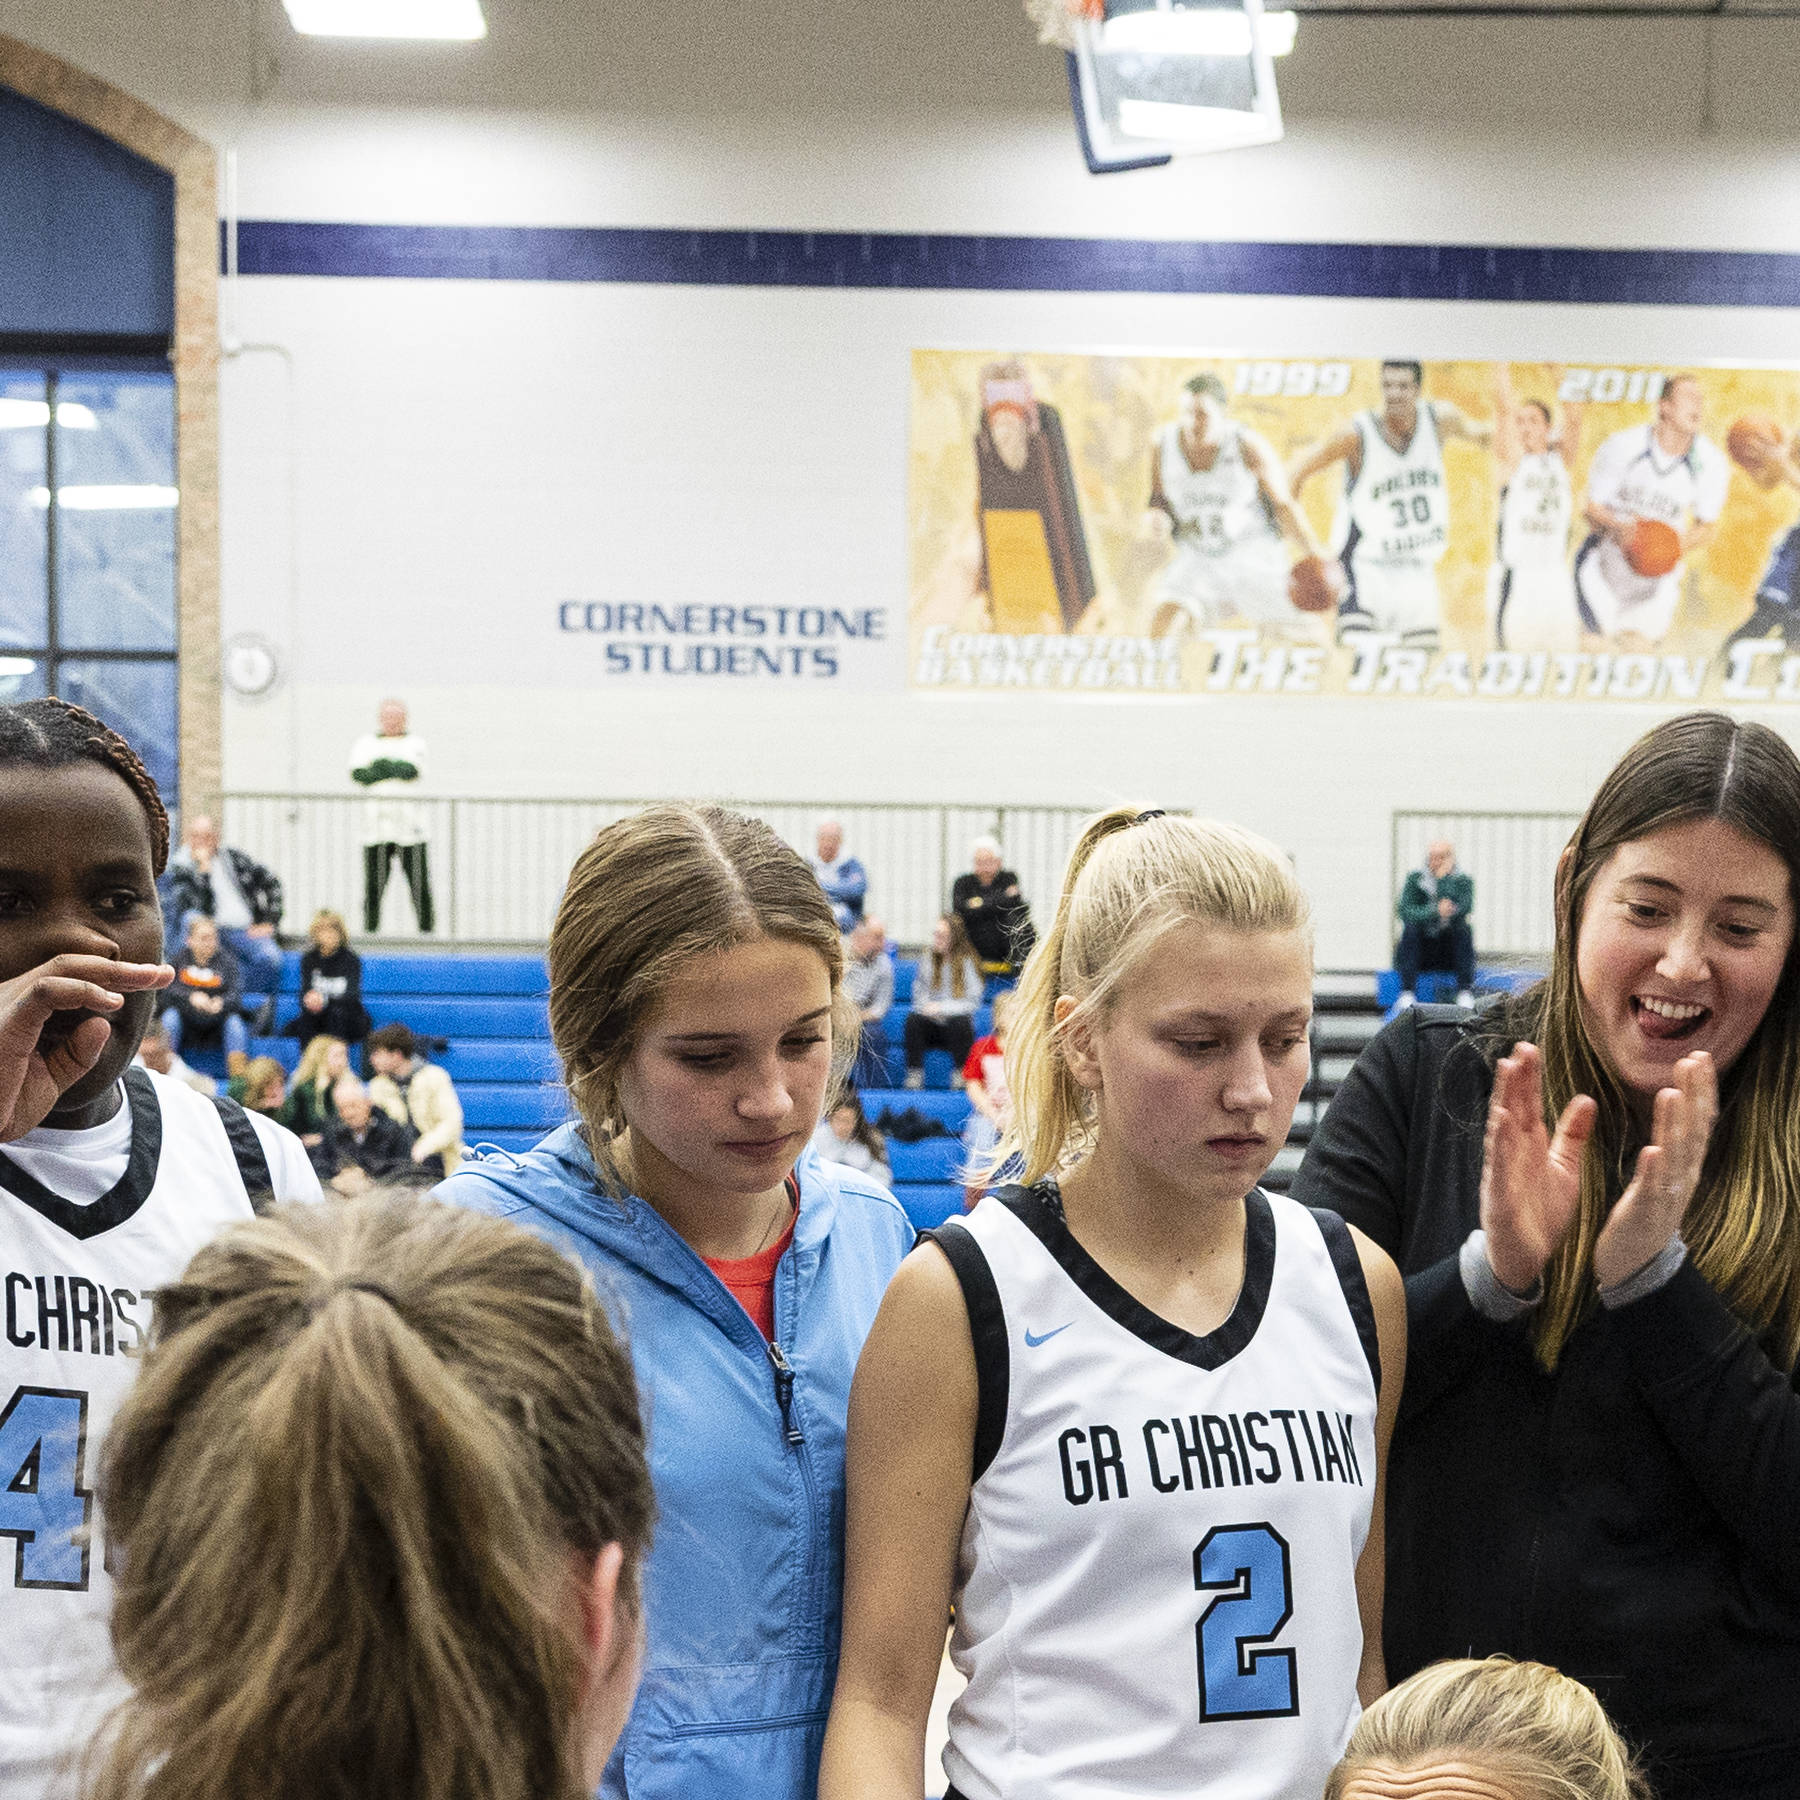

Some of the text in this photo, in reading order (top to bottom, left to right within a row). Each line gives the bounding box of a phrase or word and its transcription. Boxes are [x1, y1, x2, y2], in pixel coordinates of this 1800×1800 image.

[1235, 361, 1352, 397] 1999
[1557, 369, 1666, 403] 2011
[1390, 494, 1431, 528] 30
[557, 600, 888, 640] CORNERSTONE
[604, 642, 841, 678] STUDENTS
[913, 654, 1184, 688] BASKETBALL
[1200, 629, 1325, 692] THE
[1340, 631, 1705, 699] TRADITION
[1058, 1409, 1363, 1506] GR CHRISTIAN
[1193, 1521, 1300, 1723] 2
